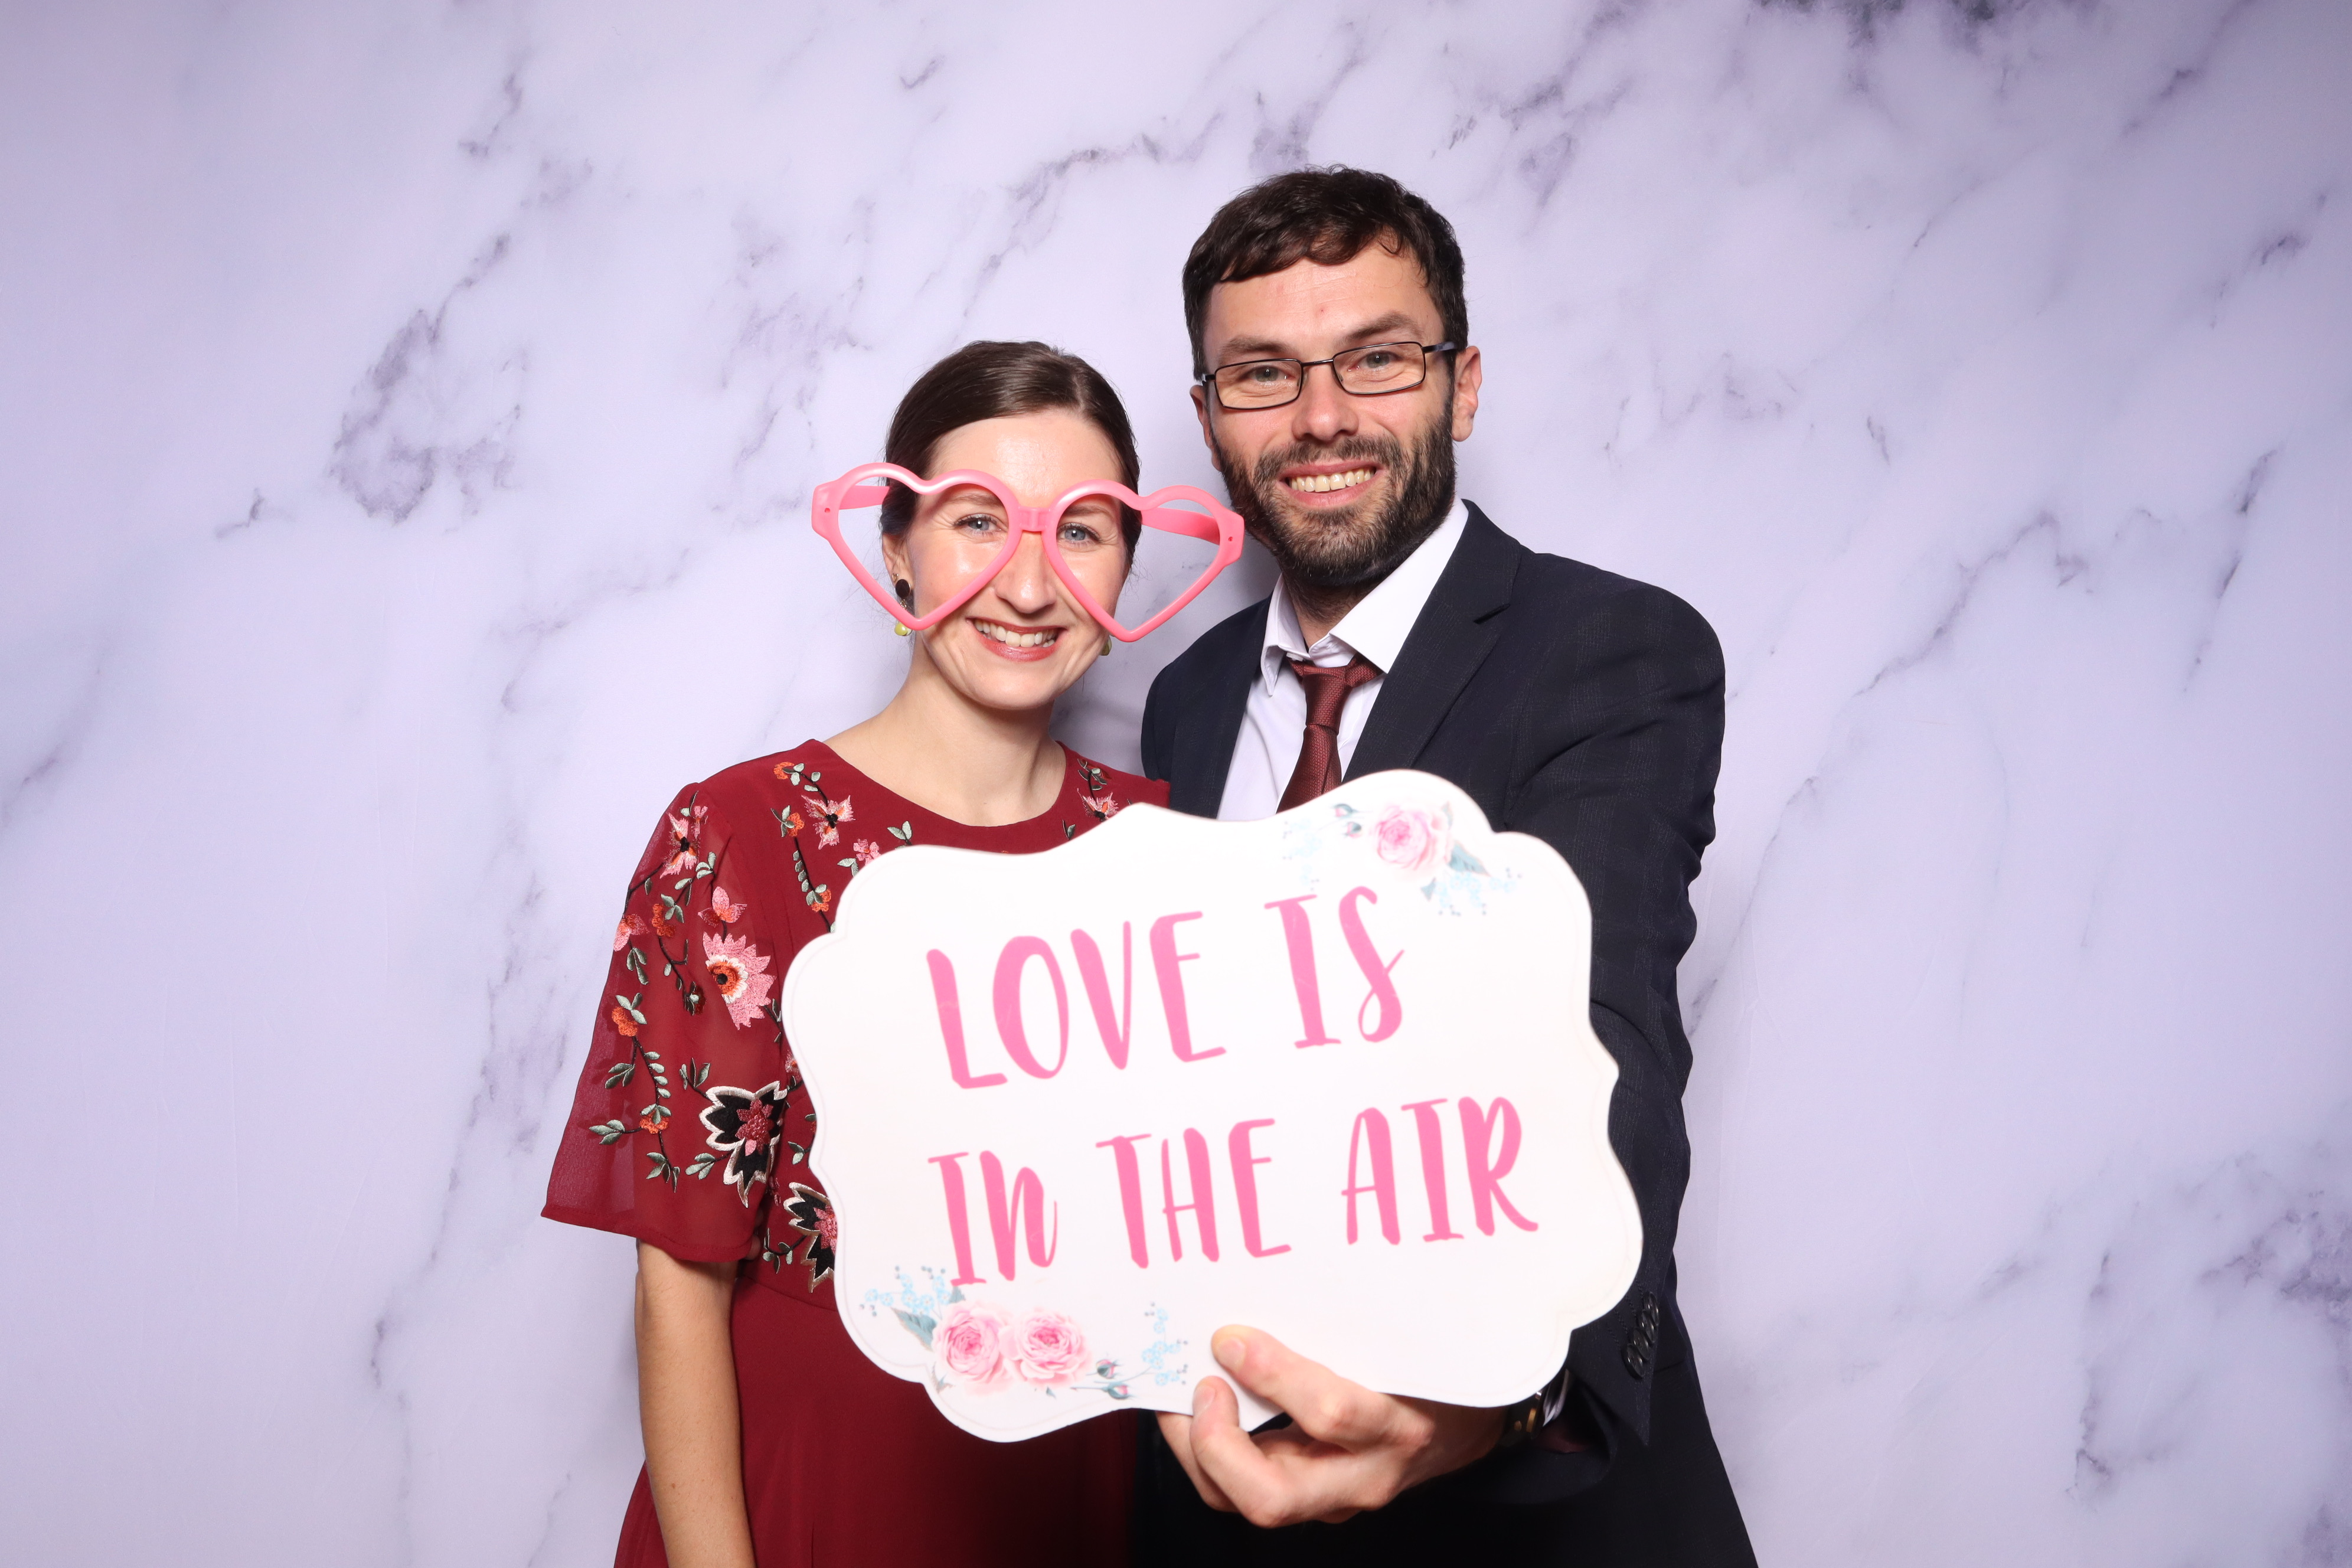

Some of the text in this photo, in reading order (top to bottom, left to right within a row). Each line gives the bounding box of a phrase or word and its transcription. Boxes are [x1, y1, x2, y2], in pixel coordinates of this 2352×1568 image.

[926, 886, 1404, 1090] LOVE IS
[1095, 1118, 1292, 1270] THE
[1340, 1096, 1539, 1246] AIR
